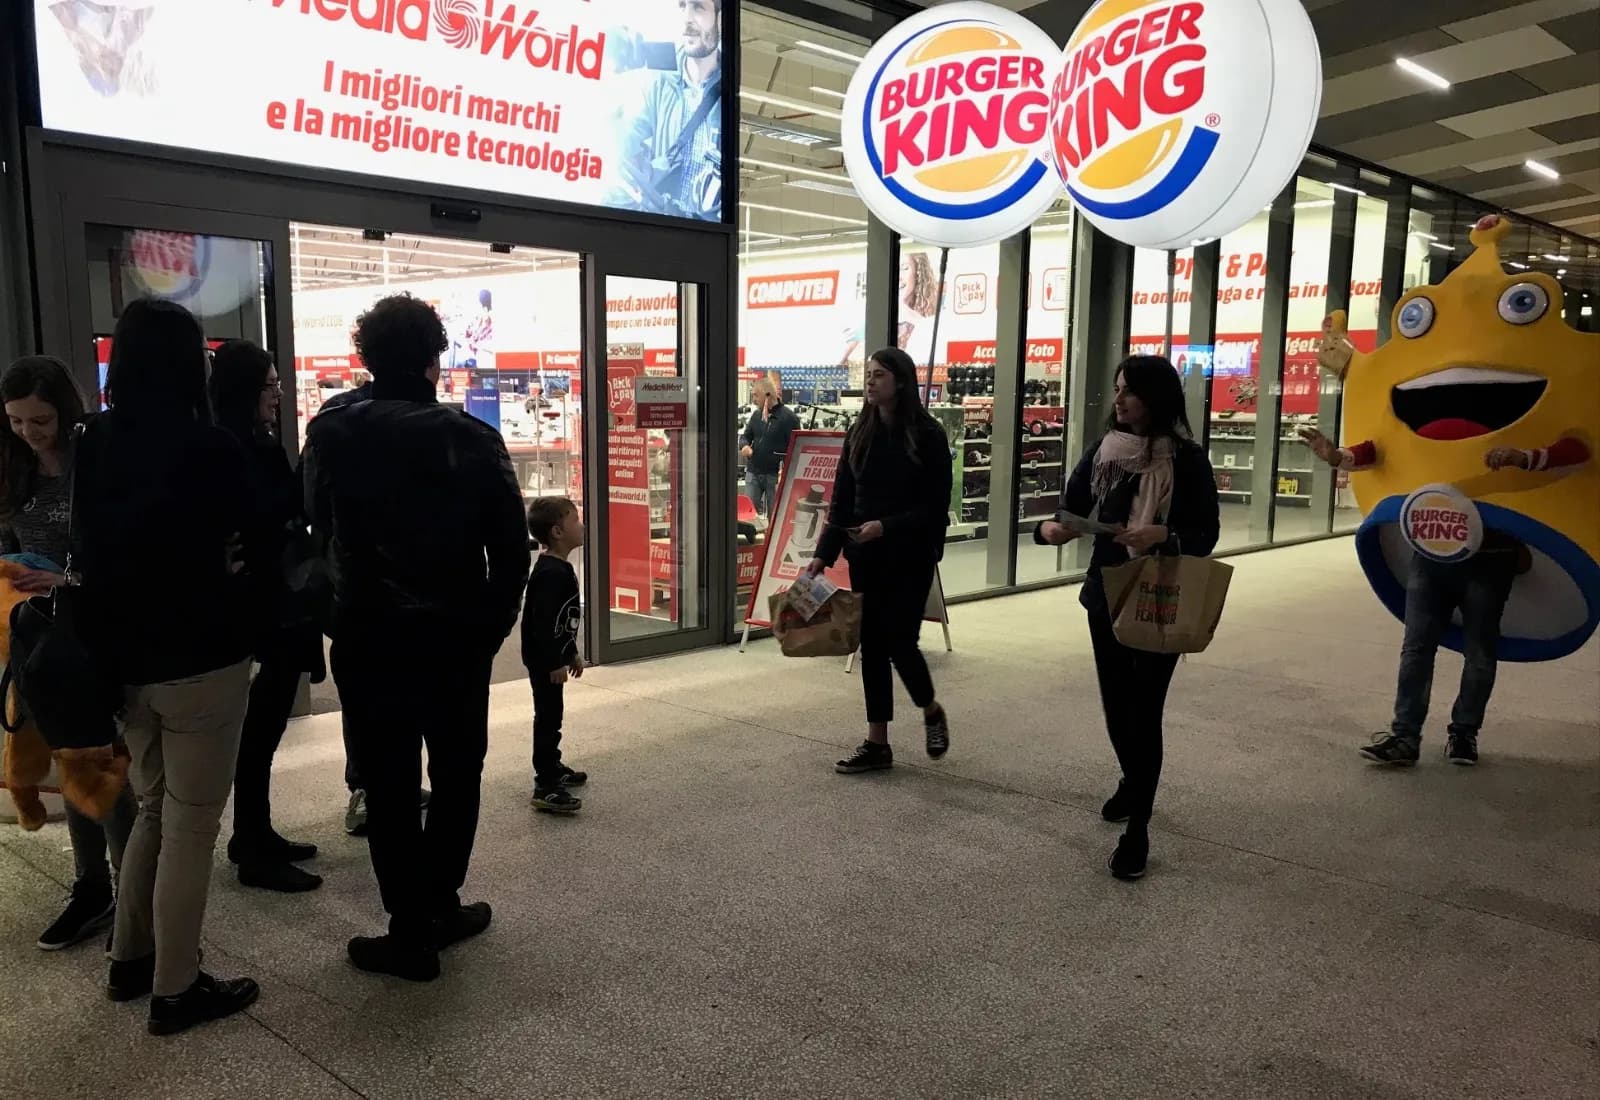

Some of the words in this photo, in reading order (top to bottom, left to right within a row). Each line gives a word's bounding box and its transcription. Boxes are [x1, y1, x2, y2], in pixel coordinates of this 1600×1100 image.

[1051, 2, 1204, 119] BURGER
[323, 60, 335, 92] I
[340, 68, 463, 115] migliori
[467, 94, 561, 133] marchi
[880, 56, 1045, 122] BURGER
[883, 90, 1050, 176] KING
[1052, 44, 1206, 182] KING
[266, 101, 287, 130] e
[293, 98, 324, 135] la
[330, 110, 461, 157] migliore
[467, 130, 603, 181] tecnologia
[1226, 254, 1243, 278] &
[749, 277, 835, 304] COMPUTER
[1302, 281, 1319, 298] in
[1027, 344, 1056, 357] Foto
[1411, 509, 1468, 526] BURGER
[1412, 522, 1468, 542] KING
